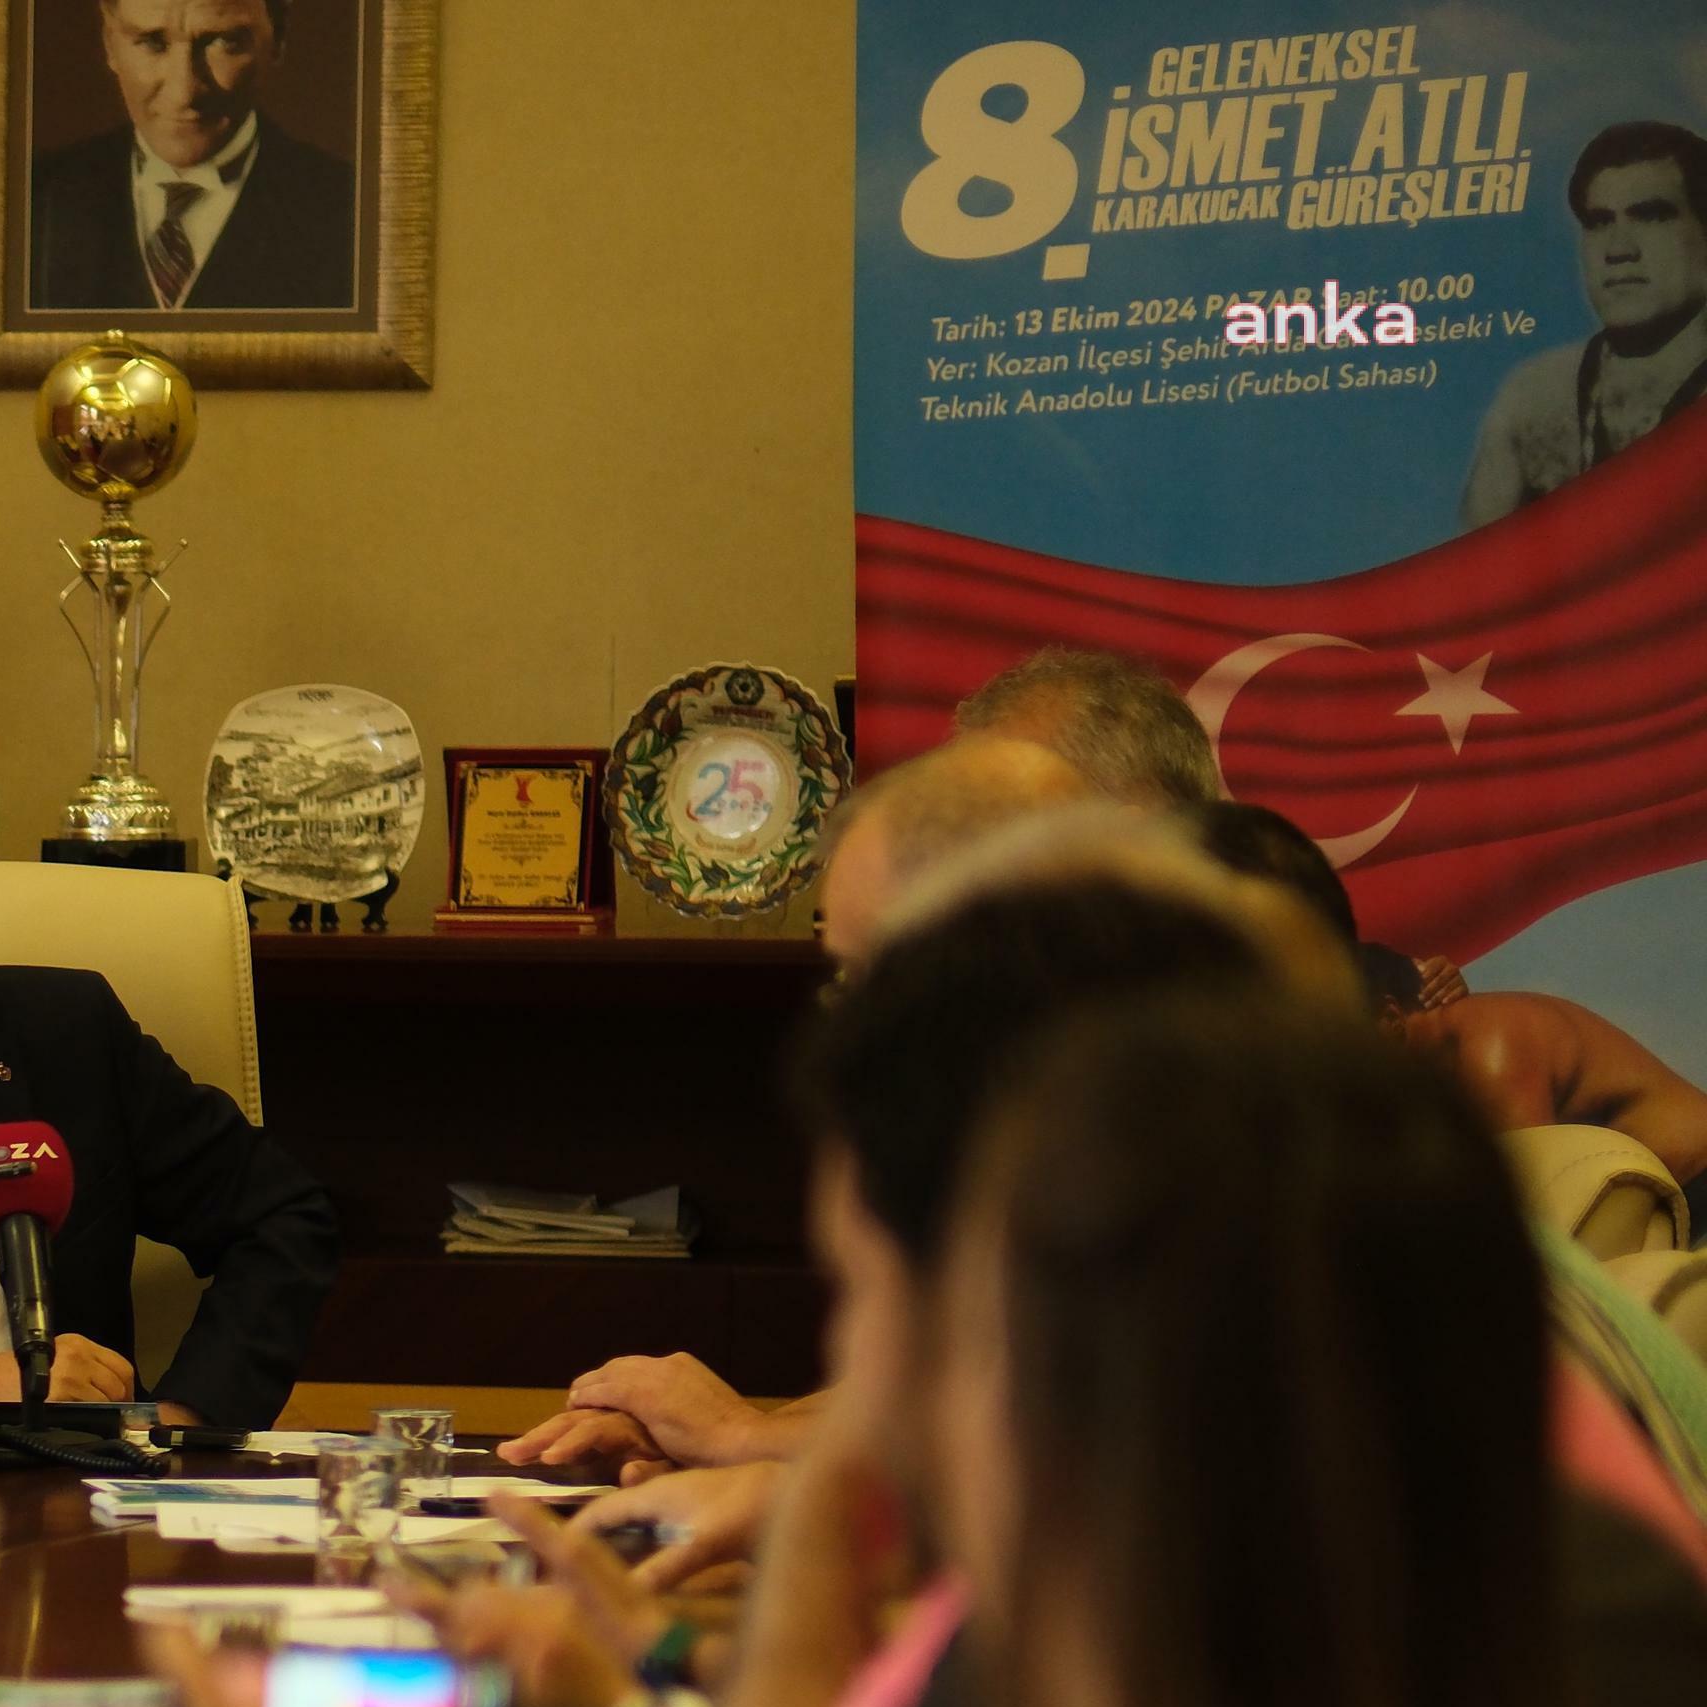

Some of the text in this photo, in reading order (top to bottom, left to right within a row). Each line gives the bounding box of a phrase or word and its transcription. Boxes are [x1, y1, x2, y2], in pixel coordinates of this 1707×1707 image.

[1148, 25, 1420, 98] GELENEKSEL
[901, 39, 1091, 281] 8.
[1096, 71, 1529, 195] İSMET ATLI
[1092, 149, 1532, 234] KARAKUCAK GÜREŞLERİ
[931, 314, 1007, 342] Tarih:
[1015, 308, 1044, 337] 13
[1051, 305, 1120, 334] Ekim
[1126, 296, 1197, 327] 2024
[1320, 284, 1388, 310] aat:
[1398, 273, 1475, 304] 10.00
[927, 357, 977, 382] Yer:
[986, 352, 1069, 378] Kozan
[1077, 338, 1153, 375] İlçesi
[1161, 336, 1230, 370] Şehit
[1503, 310, 1537, 336] Ve
[920, 359, 1437, 421] Teknik Anadolu Lisesi (Futbol Sahası)
[694, 759, 766, 817] 25
